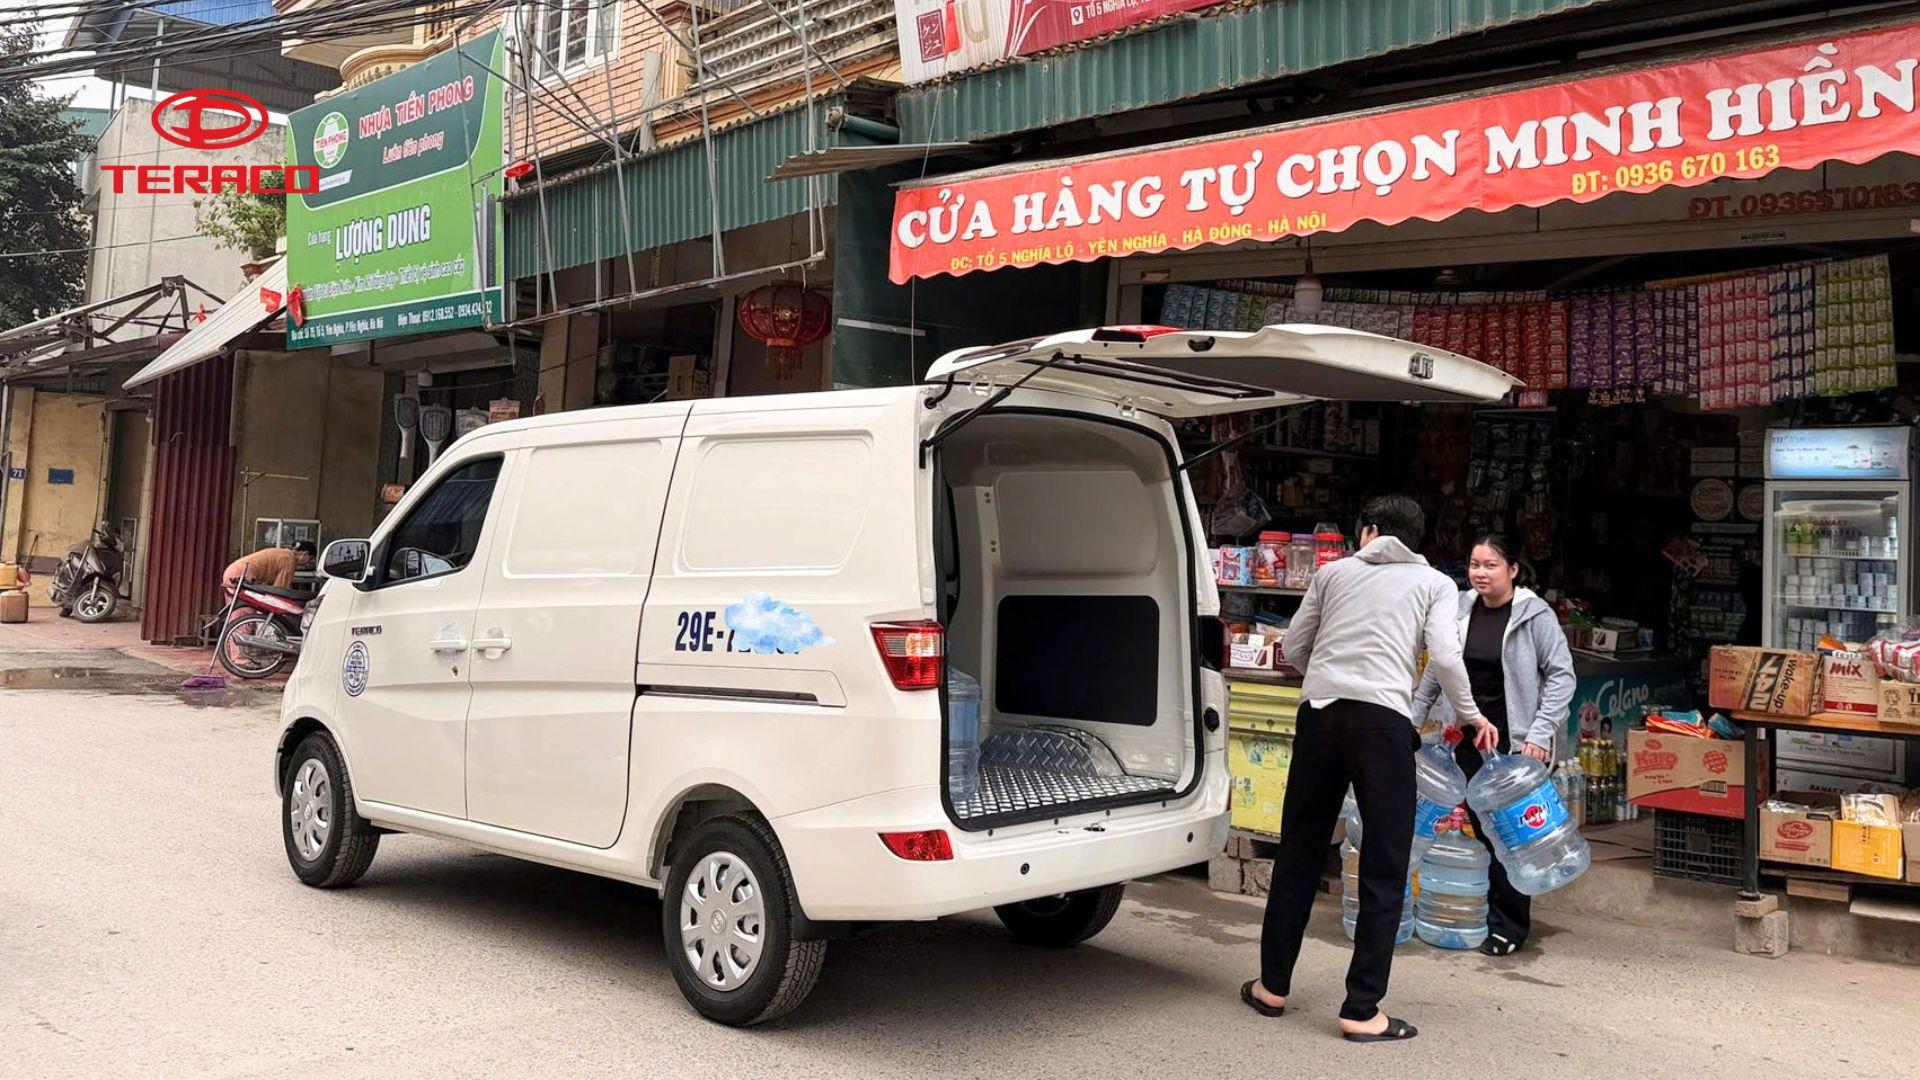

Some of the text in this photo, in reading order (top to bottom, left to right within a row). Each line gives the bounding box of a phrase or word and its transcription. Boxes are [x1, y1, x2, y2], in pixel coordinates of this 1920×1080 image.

[1097, 3, 1102, 15] 5
[359, 105, 392, 139] NHỰA
[428, 75, 474, 115] PHONG
[898, 43, 1919, 248] CỬA HÀNG TỰ CHỌN MINH HIỀN
[1571, 145, 1781, 195] ĐT: 0936 670 163
[335, 216, 383, 265] LƯỢNG
[387, 203, 431, 250] DUNG
[951, 256, 973, 270] ĐC:
[978, 248, 994, 267] TỔ
[999, 252, 1007, 264] 5
[1012, 248, 1051, 262] NGHĨA
[1088, 235, 1118, 254] YÊN
[1122, 230, 1167, 250] NGHĨA
[1183, 227, 1203, 243] HÀ
[1209, 223, 1253, 241] ĐÔNG
[1268, 215, 1290, 234] HÀ
[1297, 211, 1327, 231] NỘI
[12, 469, 22, 478] 71
[1597, 678, 1649, 718] Celano
